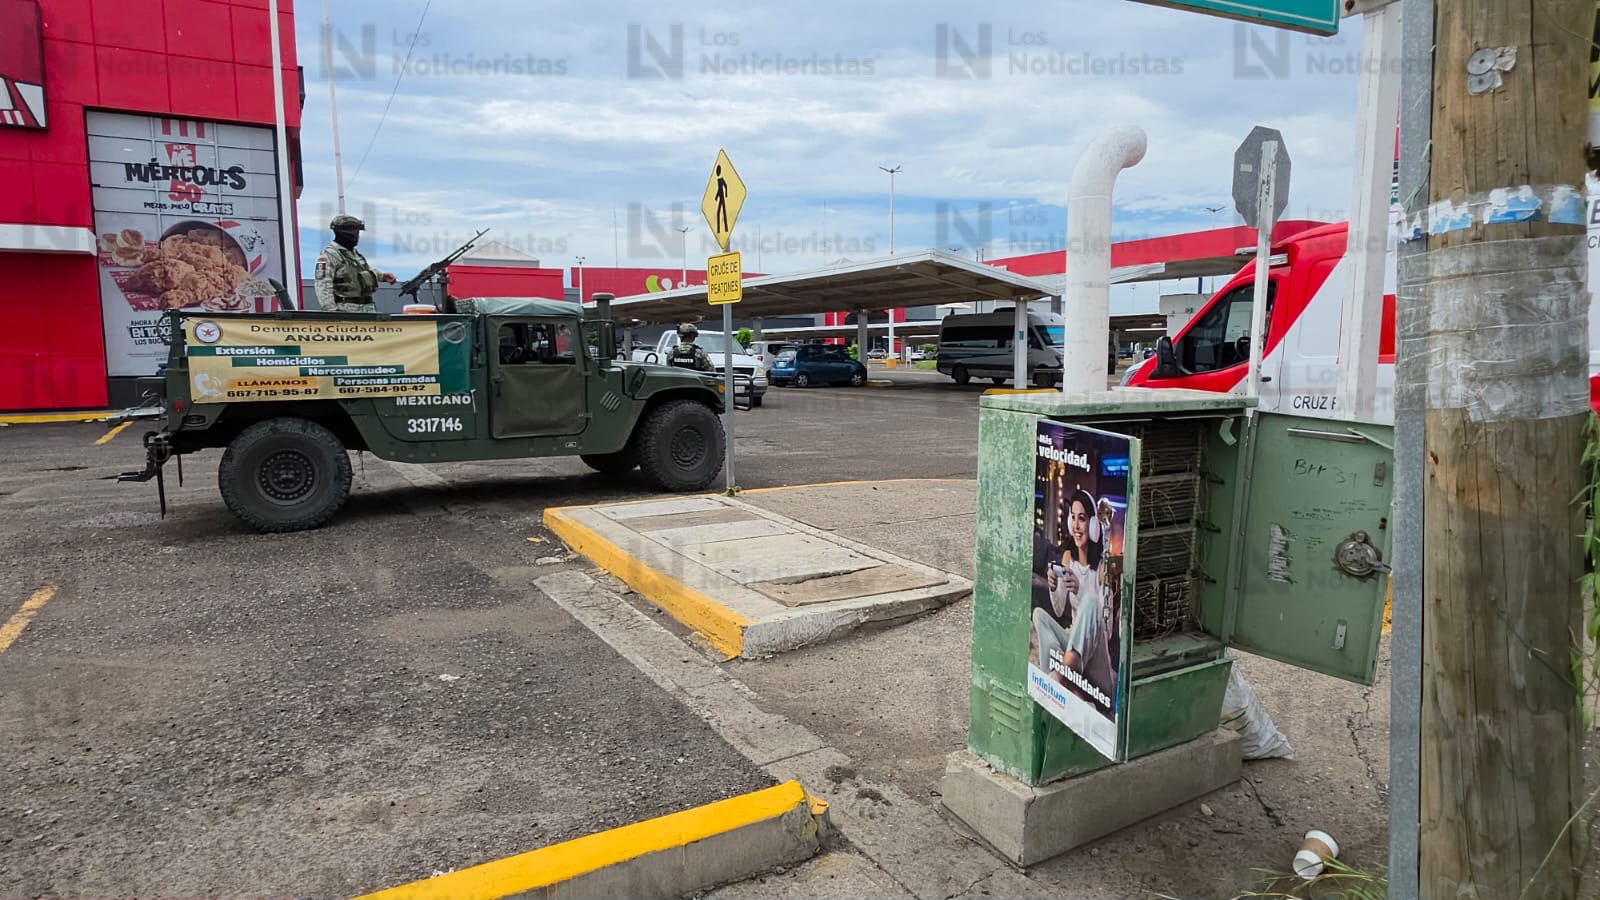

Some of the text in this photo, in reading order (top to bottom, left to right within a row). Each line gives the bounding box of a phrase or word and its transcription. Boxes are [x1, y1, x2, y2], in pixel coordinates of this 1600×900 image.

[124, 157, 247, 190] MIÉRCOLES
[711, 261, 738, 276] CRUCE DE
[711, 280, 738, 295] PEATONES
[251, 325, 403, 333] Denuncia Ciudadana
[284, 333, 374, 342] ANÓNIMA
[215, 346, 276, 355] Extorsión
[256, 357, 326, 366] Homicidios
[308, 366, 397, 375] Narcomenudeo
[237, 379, 308, 387] LLÁMANOS
[337, 375, 436, 385] Personas armadas
[227, 388, 319, 398] 667-715-95-87
[396, 395, 471, 406] MEXICANO
[1293, 395, 1328, 410] CRUZ
[407, 417, 463, 433] 3317146
[1038, 445, 1091, 472] velocidad,
[1031, 671, 1066, 705] infinitum
[1049, 658, 1111, 708] posibilidades
